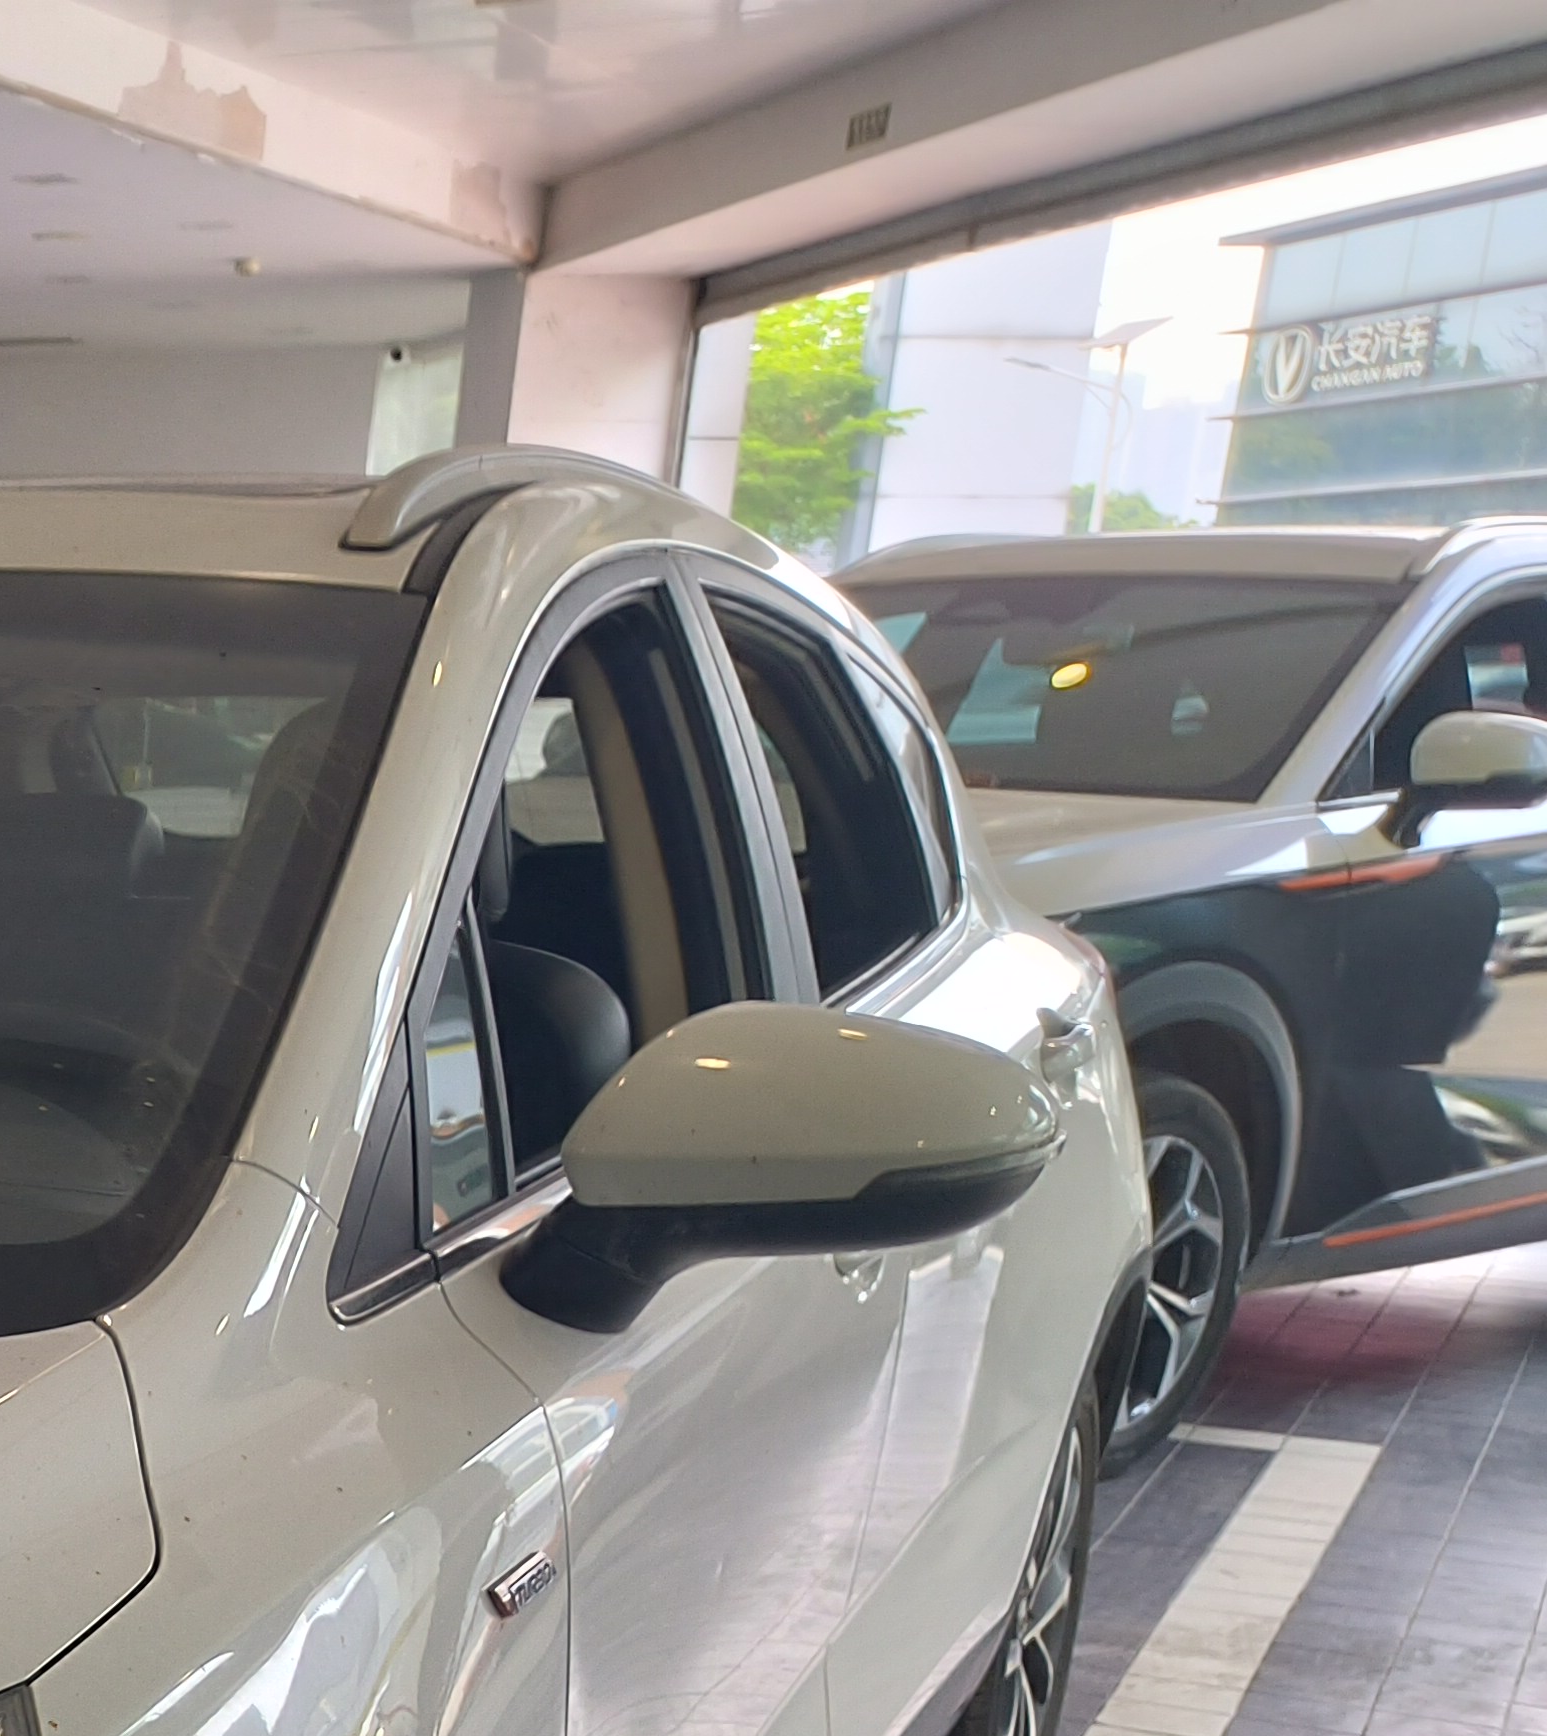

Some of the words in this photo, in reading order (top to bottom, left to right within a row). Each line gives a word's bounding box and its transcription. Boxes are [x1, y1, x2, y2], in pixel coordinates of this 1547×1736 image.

[1317, 314, 1432, 372] 长安汽车
[1310, 367, 1379, 392] CHANGAN
[1380, 360, 1424, 382] AUTO
